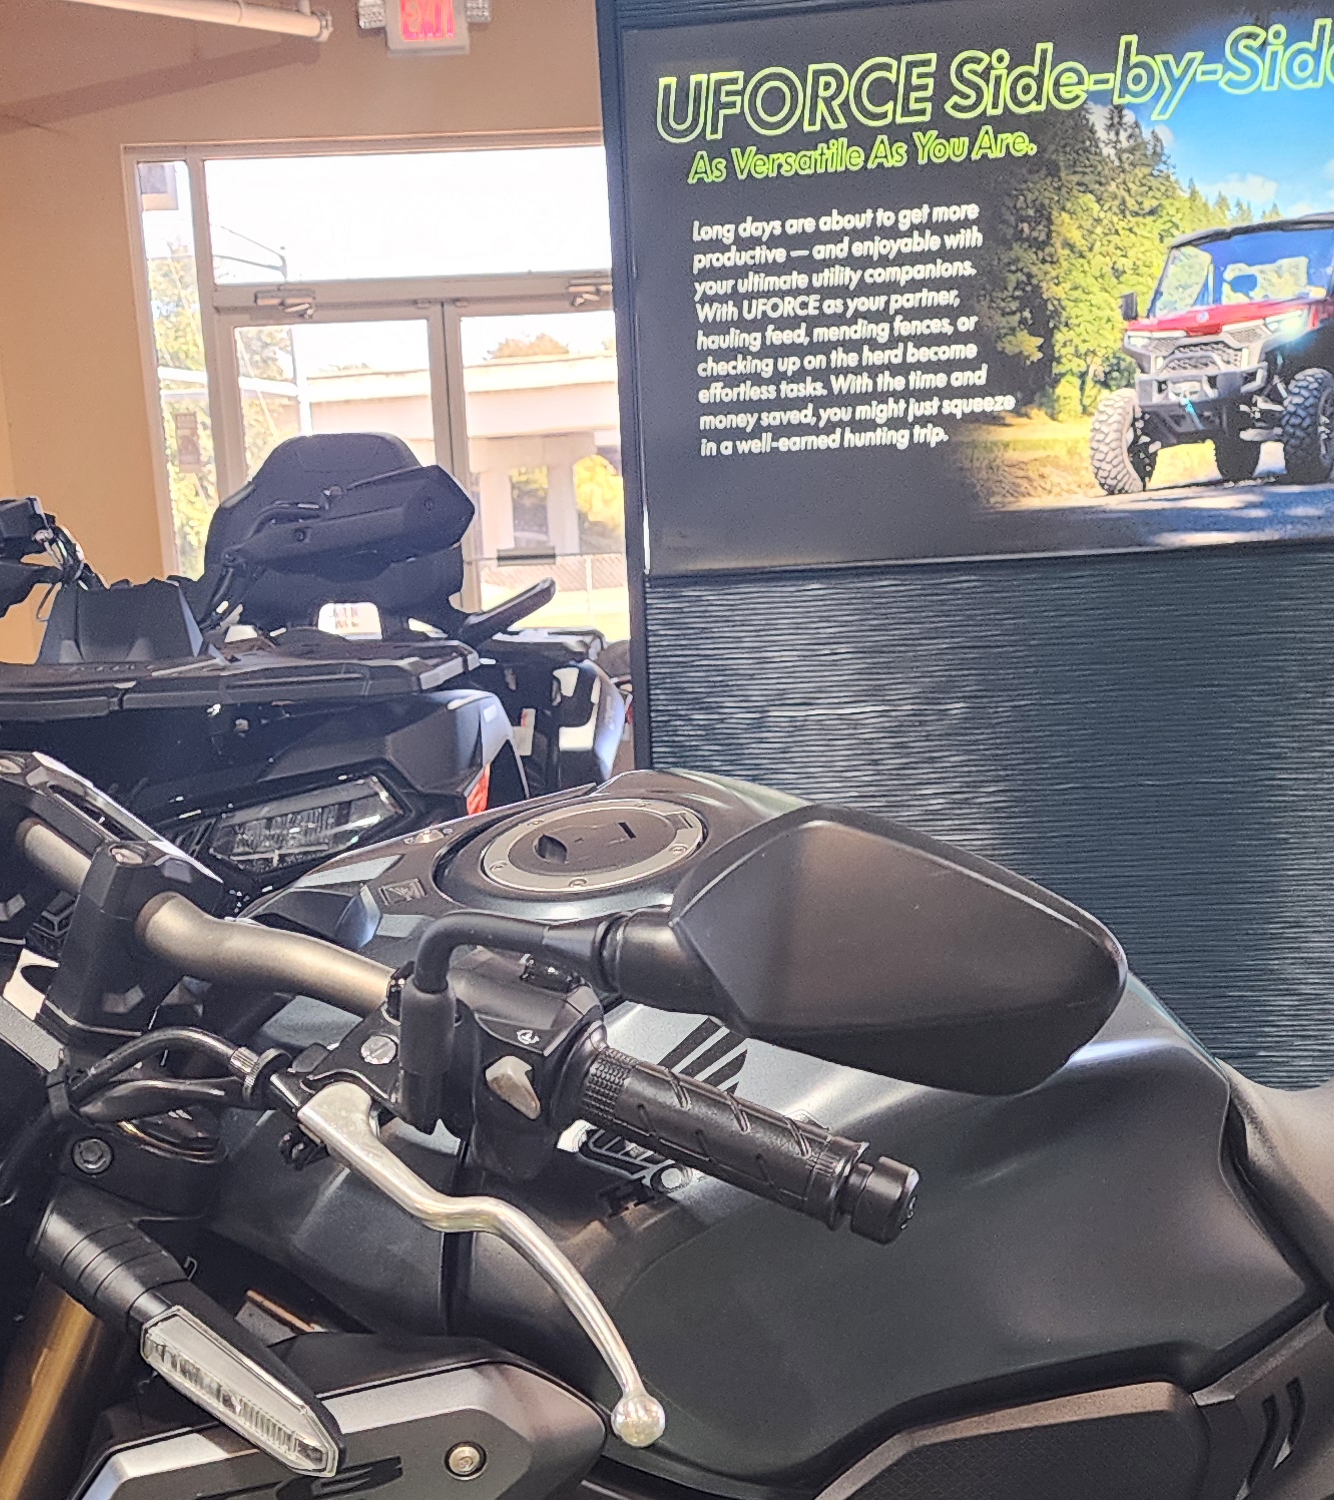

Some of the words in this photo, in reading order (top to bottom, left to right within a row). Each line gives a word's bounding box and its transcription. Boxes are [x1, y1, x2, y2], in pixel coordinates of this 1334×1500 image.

[657, 53, 937, 143] UFORCE
[687, 150, 726, 184] As
[731, 136, 864, 180] Versatile
[868, 135, 907, 169] As
[912, 130, 969, 165] You
[972, 125, 1037, 162] Are.
[693, 221, 734, 245] Long
[738, 217, 781, 242] days
[786, 218, 815, 234] are
[819, 209, 873, 231] about
[876, 208, 895, 227] to
[898, 205, 930, 231] get
[933, 205, 979, 222] more
[693, 245, 786, 274] productive
[813, 237, 848, 259] and
[852, 231, 940, 261] enjoyable
[944, 227, 982, 249] with
[694, 279, 734, 302] your
[738, 270, 808, 292] ultimate
[812, 265, 861, 290] utility
[864, 259, 976, 286] companions.
[696, 300, 738, 322] With
[743, 294, 820, 319] UFORCE
[822, 298, 842, 313] as
[846, 295, 885, 318] your
[890, 288, 960, 315] partner,
[697, 327, 761, 352] hauling
[765, 323, 810, 346] feed,
[813, 319, 889, 343] mending
[894, 316, 953, 336] fences,
[957, 316, 978, 332] or
[698, 354, 773, 378] checking
[777, 356, 800, 376] up
[804, 354, 826, 369] on
[830, 347, 859, 367] the
[862, 343, 903, 365] herd
[907, 342, 978, 362] become
[699, 380, 776, 403] effortless
[780, 376, 827, 398] tasks.
[831, 372, 873, 394] With
[876, 371, 905, 391] the
[909, 370, 947, 389] time
[951, 365, 988, 387] and
[700, 412, 758, 432] money
[760, 403, 816, 426] saved,
[819, 406, 852, 427] you
[856, 397, 906, 424] might
[909, 396, 940, 422] just
[942, 395, 1016, 419] squeeze
[701, 437, 716, 456] in
[720, 440, 733, 454] a
[737, 427, 842, 453] well-earned
[844, 426, 909, 449] hunting
[914, 423, 949, 447] trip.
